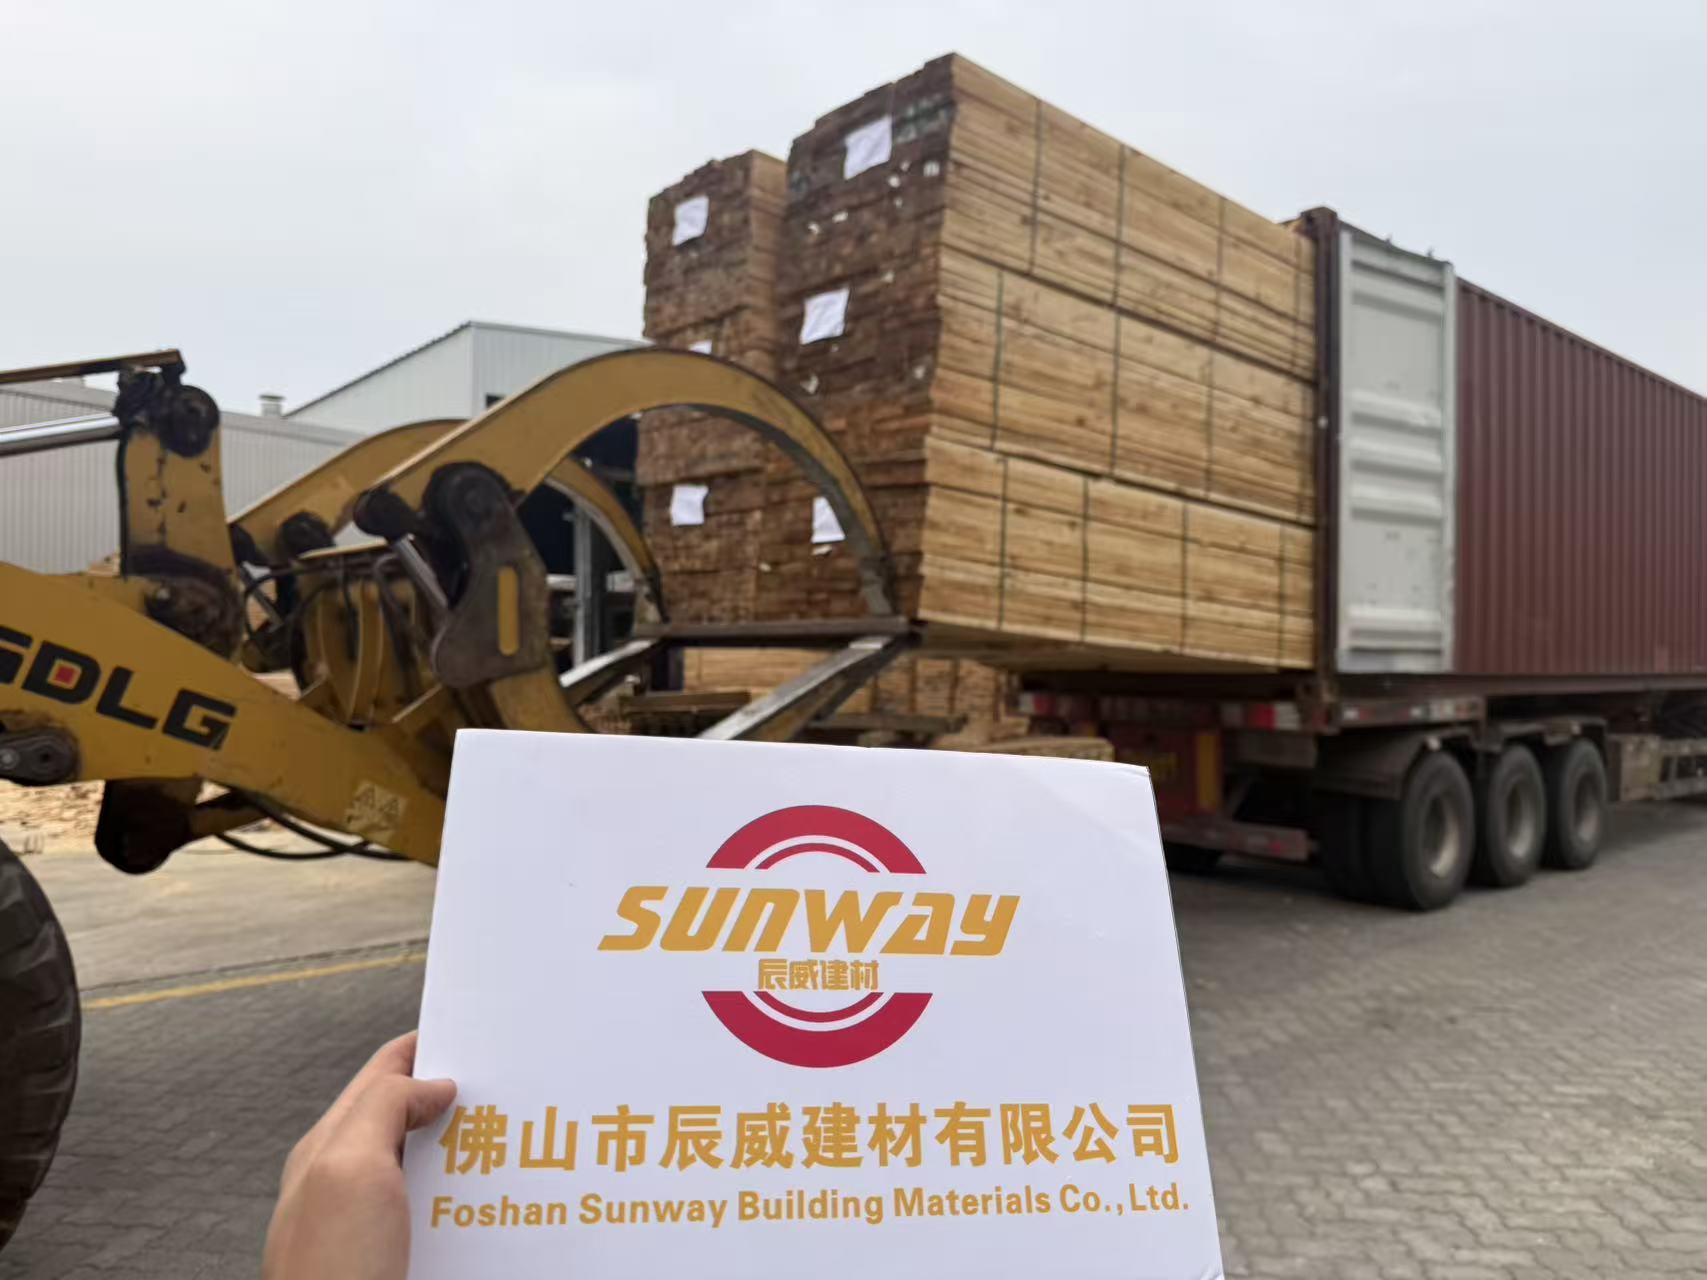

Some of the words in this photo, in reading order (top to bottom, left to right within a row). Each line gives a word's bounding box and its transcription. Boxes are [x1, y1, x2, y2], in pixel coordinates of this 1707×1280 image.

[757, 958, 880, 991] 辰威建材
[439, 1101, 1181, 1176] 佛山市辰威建材有限公司
[431, 1195, 568, 1228] Foshan
[578, 1192, 729, 1229] Sunway
[738, 1189, 884, 1225] Building
[893, 1185, 1052, 1217] Materials
